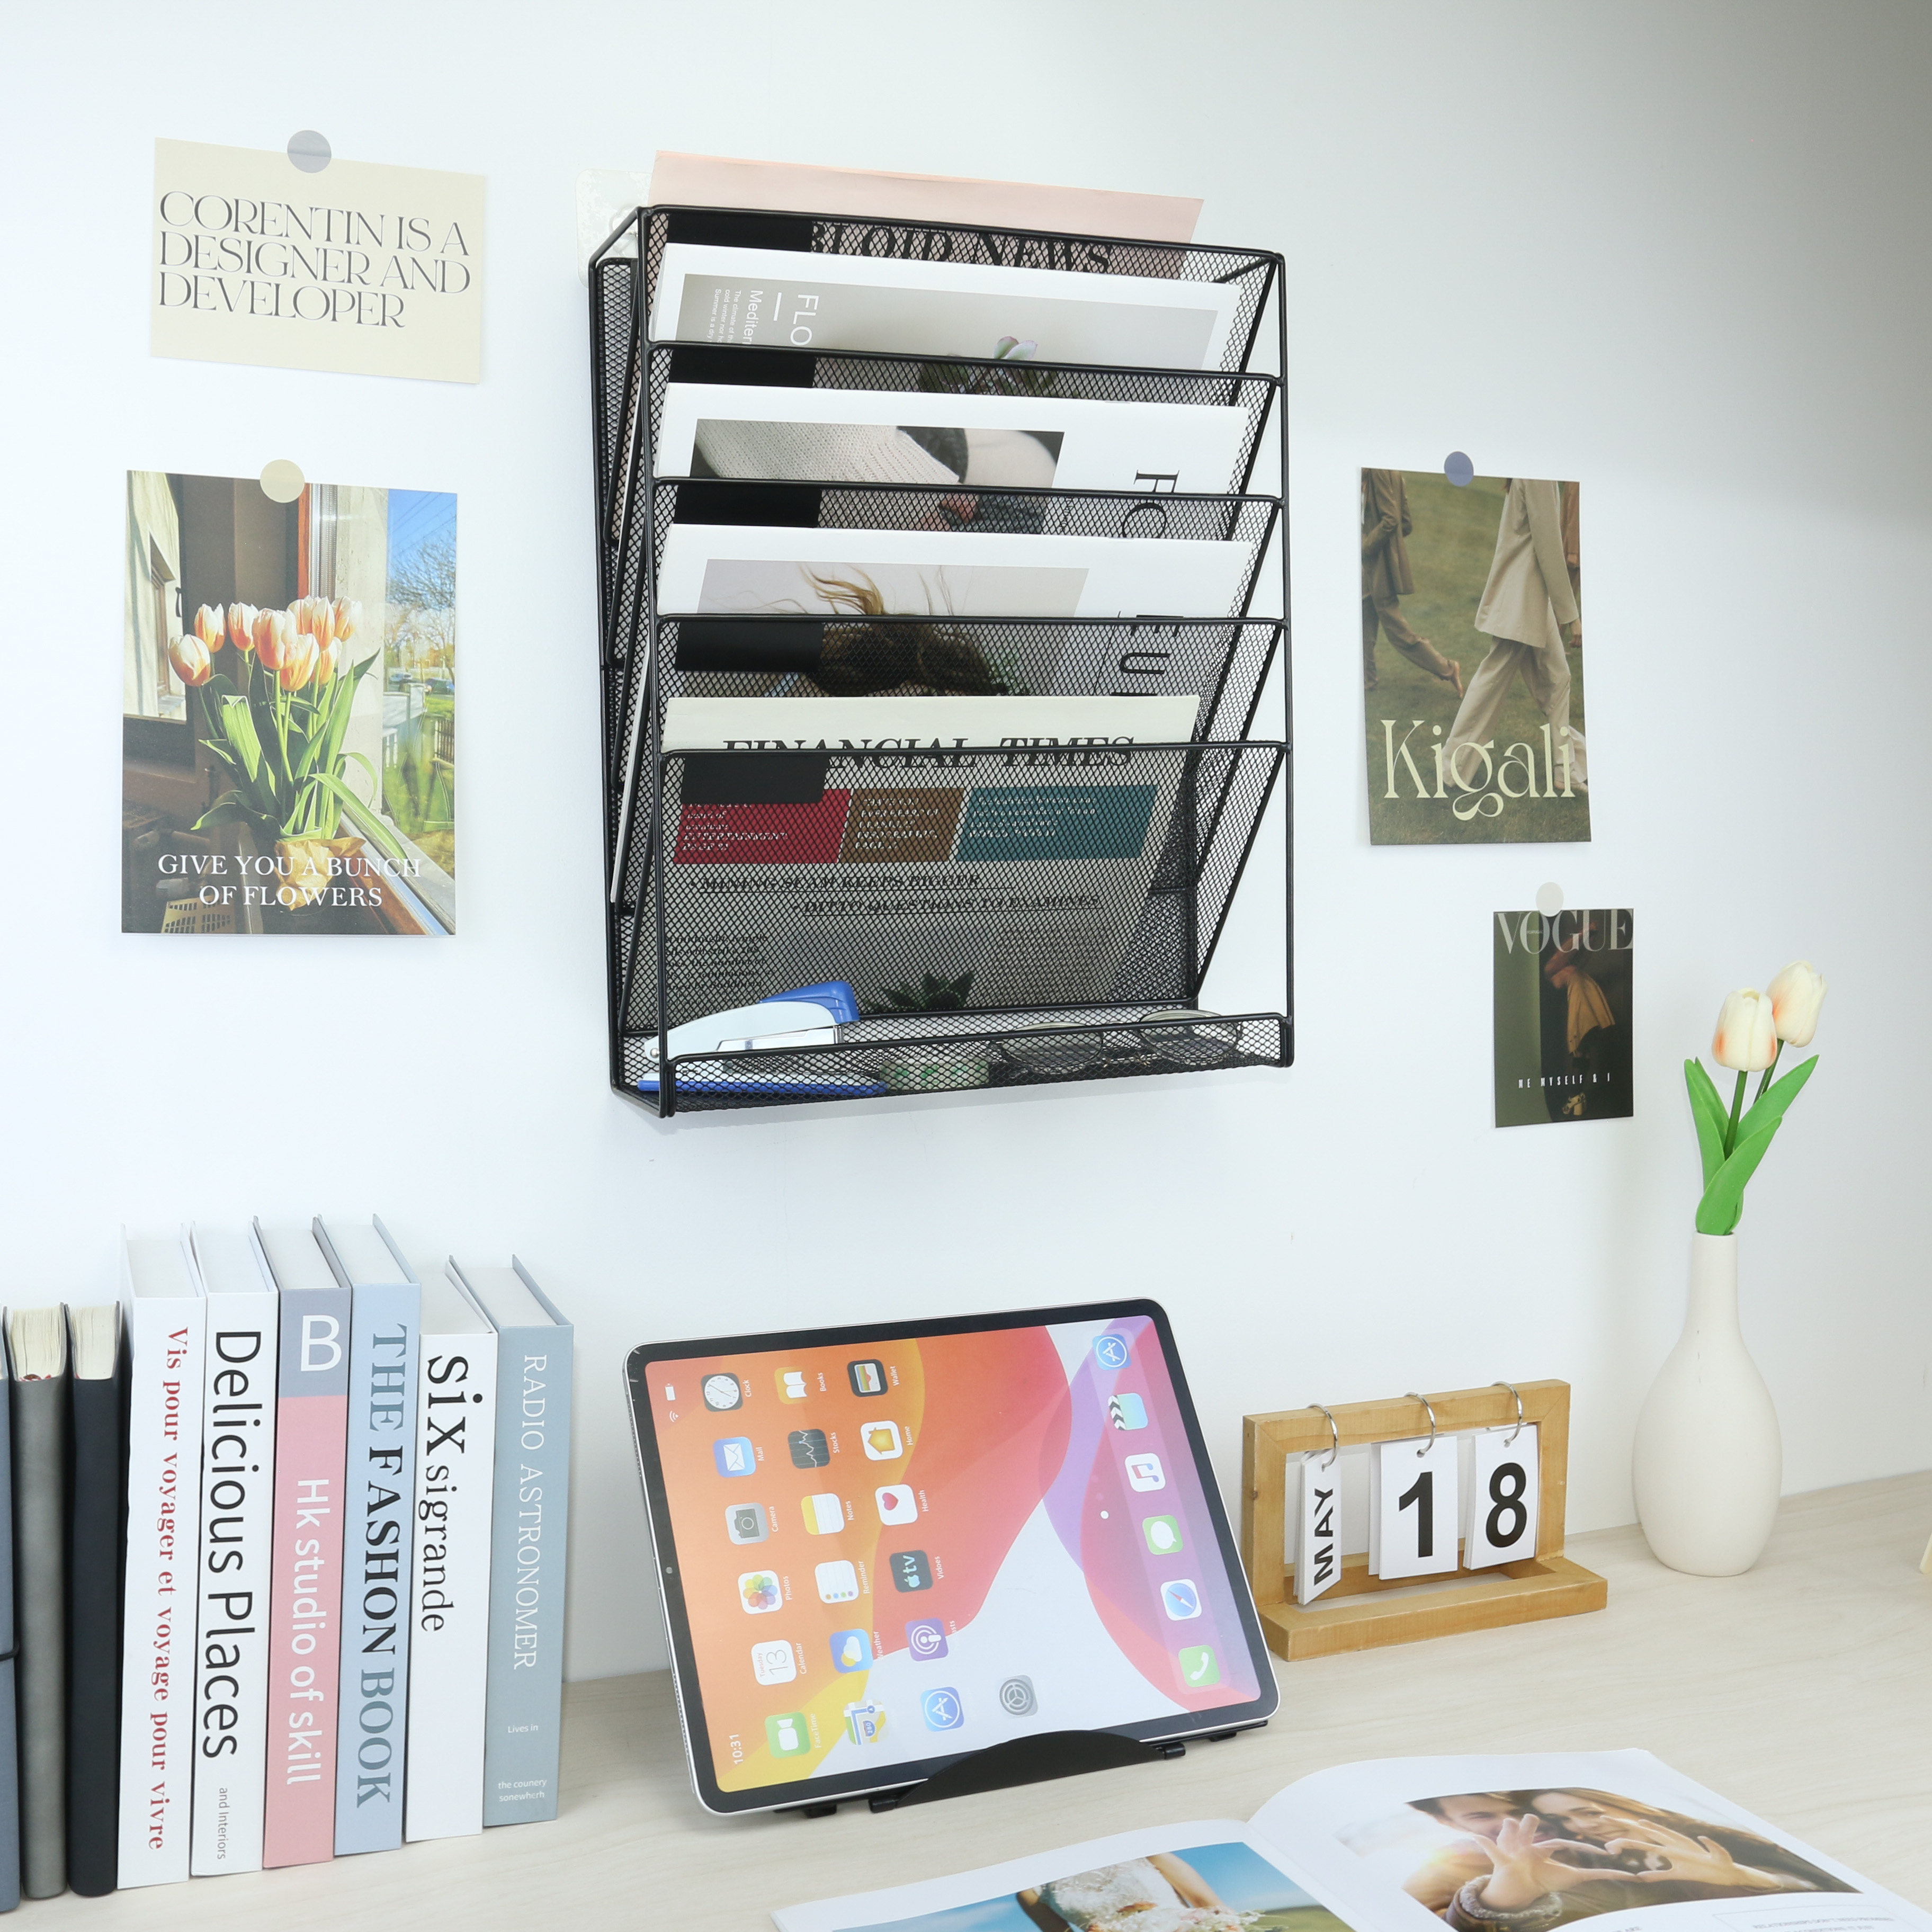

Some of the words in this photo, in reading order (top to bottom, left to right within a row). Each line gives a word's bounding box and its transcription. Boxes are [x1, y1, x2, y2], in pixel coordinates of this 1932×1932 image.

[160, 191, 386, 248] CORENTIN
[397, 216, 432, 252] IS
[440, 222, 469, 256] A
[160, 231, 371, 285] DESIGNER
[379, 255, 470, 293] AND
[159, 272, 406, 328] DEVELOPER
[712, 289, 721, 315] Summer
[729, 304, 739, 326] climate
[1381, 719, 1576, 821] Kigali
[158, 854, 227, 875] GIVE
[235, 856, 293, 875] YOU
[301, 857, 319, 876] A
[327, 857, 421, 878] BUNCH
[199, 885, 237, 905] OF
[243, 886, 382, 907] FLOWERS
[1495, 909, 1633, 954] VOGUE
[1518, 1078, 1531, 1088] ME
[1541, 1075, 1582, 1086] MYSELF
[166, 1327, 189, 1369] Vis
[300, 1314, 342, 1372] B
[370, 1323, 407, 1432] THE
[743, 1379, 752, 1397] Clock
[817, 1372, 826, 1392] Books
[890, 1366, 899, 1386] Wallet
[162, 1380, 181, 1441] pour
[521, 1355, 547, 1450] RADIO
[208, 1331, 263, 1573] Delicious
[755, 1446, 765, 1461] Mail
[830, 1432, 839, 1453] Stocks
[905, 1426, 913, 1446] Home
[157, 1452, 178, 1561] voyager
[296, 1479, 330, 1529] Hk
[769, 1506, 778, 1532] Camera
[845, 1501, 854, 1521] Notes
[919, 1489, 928, 1513] Health
[1313, 1488, 1334, 1586] MAY
[1399, 1471, 1433, 1558] 1
[1486, 1462, 1527, 1548] 8
[362, 1445, 403, 1654] FASHON
[418, 1464, 457, 1632] sigrande
[514, 1463, 543, 1670] ASTRONOMER
[158, 1571, 177, 1596] et
[858, 1561, 870, 1594] Reminder
[935, 1556, 944, 1580] Vidoes
[292, 1539, 326, 1654] studio
[783, 1576, 792, 1601] Photos
[151, 1607, 172, 1701] voyage
[757, 1652, 766, 1677] Tuesday
[766, 1649, 788, 1675] 13
[795, 1643, 807, 1675] Calendar
[203, 1592, 255, 1758] Places
[290, 1666, 324, 1701] of
[150, 1711, 168, 1770] pour
[287, 1711, 322, 1785] skill
[356, 1667, 394, 1809] BOOK
[729, 1733, 744, 1765] 10:31
[810, 1713, 821, 1749] FaceTime
[148, 1781, 171, 1850] vivre
[218, 1787, 230, 1808] and
[217, 1811, 229, 1859] Interiors
